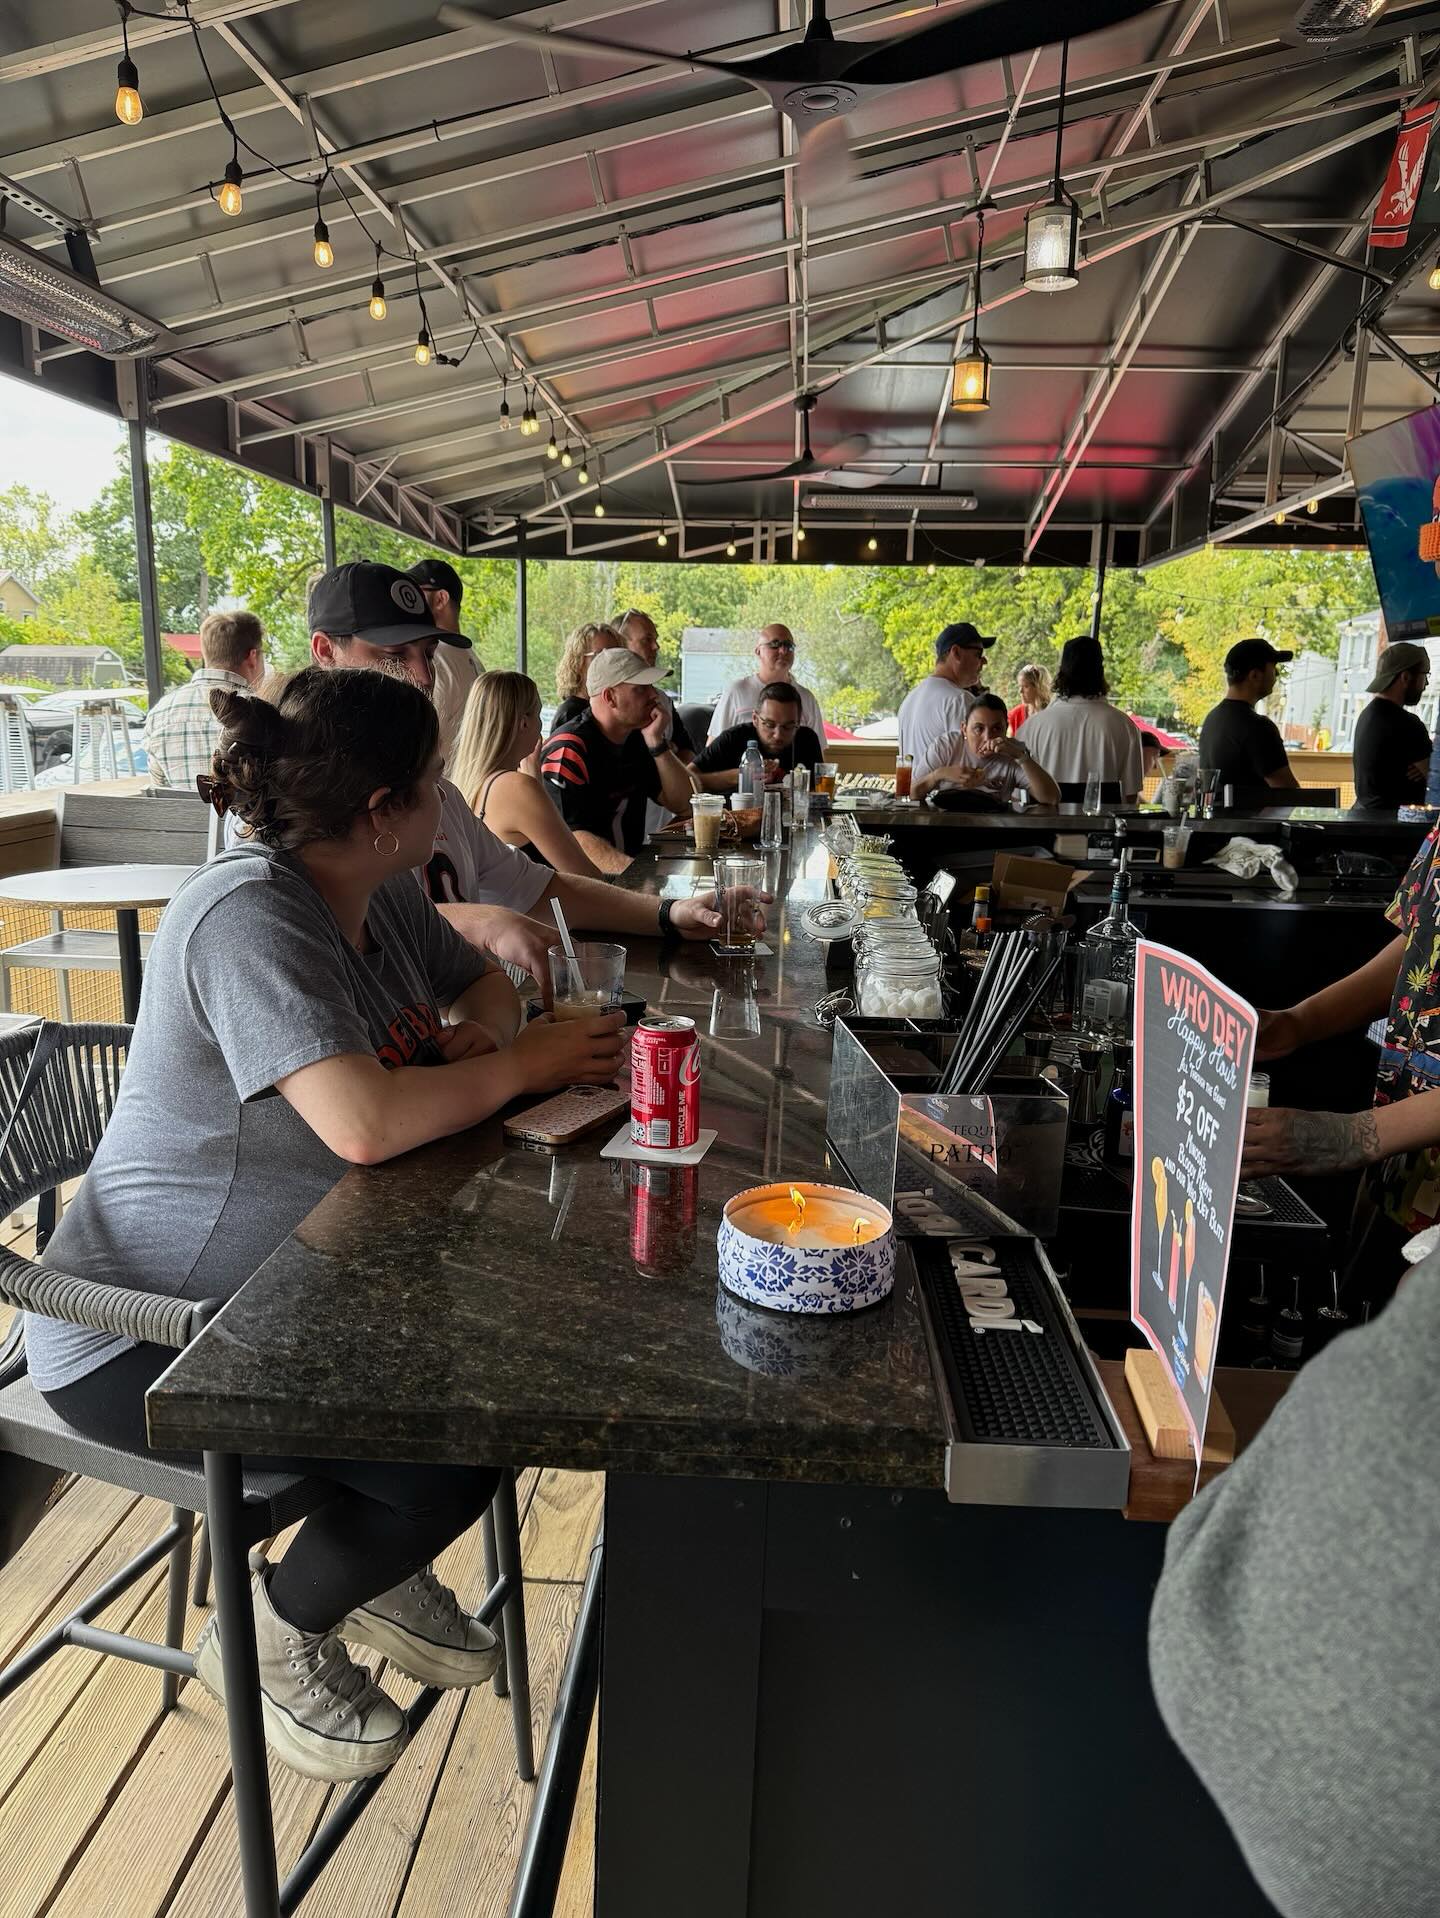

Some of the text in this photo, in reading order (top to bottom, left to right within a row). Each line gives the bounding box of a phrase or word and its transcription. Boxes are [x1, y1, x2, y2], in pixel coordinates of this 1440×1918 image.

[1161, 966, 1210, 1033] WHO
[1213, 1001, 1248, 1069] DEY
[1167, 1003, 1207, 1071] Happy
[1209, 1037, 1237, 1090] Hour
[677, 1090, 686, 1146] RECYCLE ME
[1176, 1079, 1220, 1149] $2 OFF
